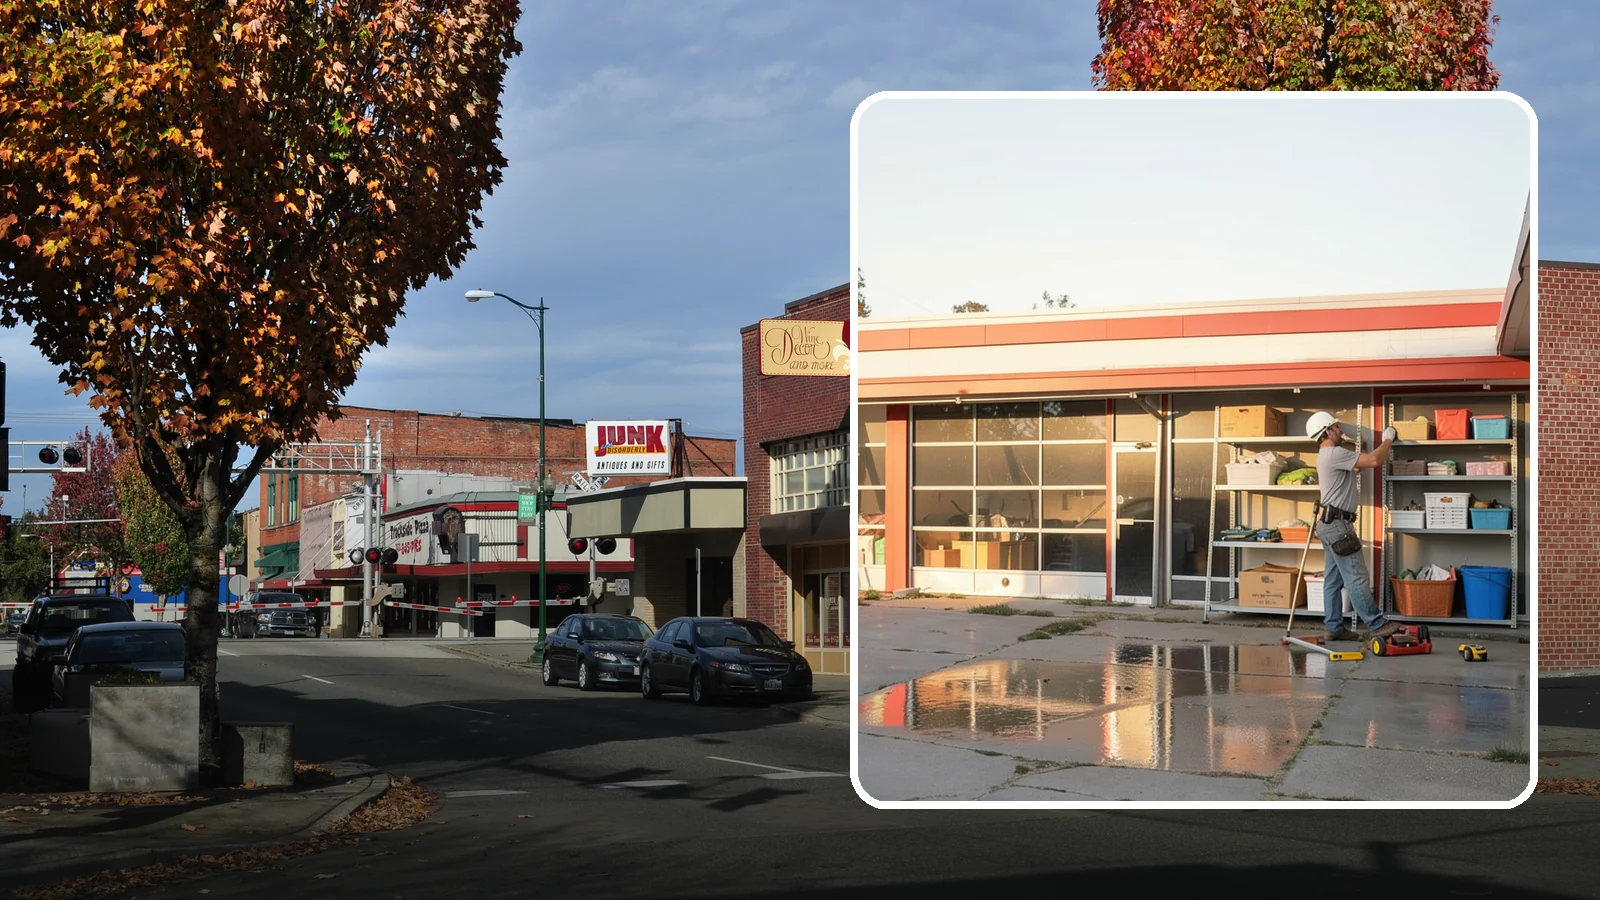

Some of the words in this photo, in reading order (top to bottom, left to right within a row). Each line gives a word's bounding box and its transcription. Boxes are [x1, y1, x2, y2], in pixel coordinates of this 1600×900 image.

[594, 425, 665, 457] JUNK
[607, 446, 646, 454] DISORDERLY
[597, 461, 628, 470] ANTIQUES
[631, 461, 644, 470] AND
[647, 460, 665, 469] GIFTS
[414, 519, 429, 535] Pizza
